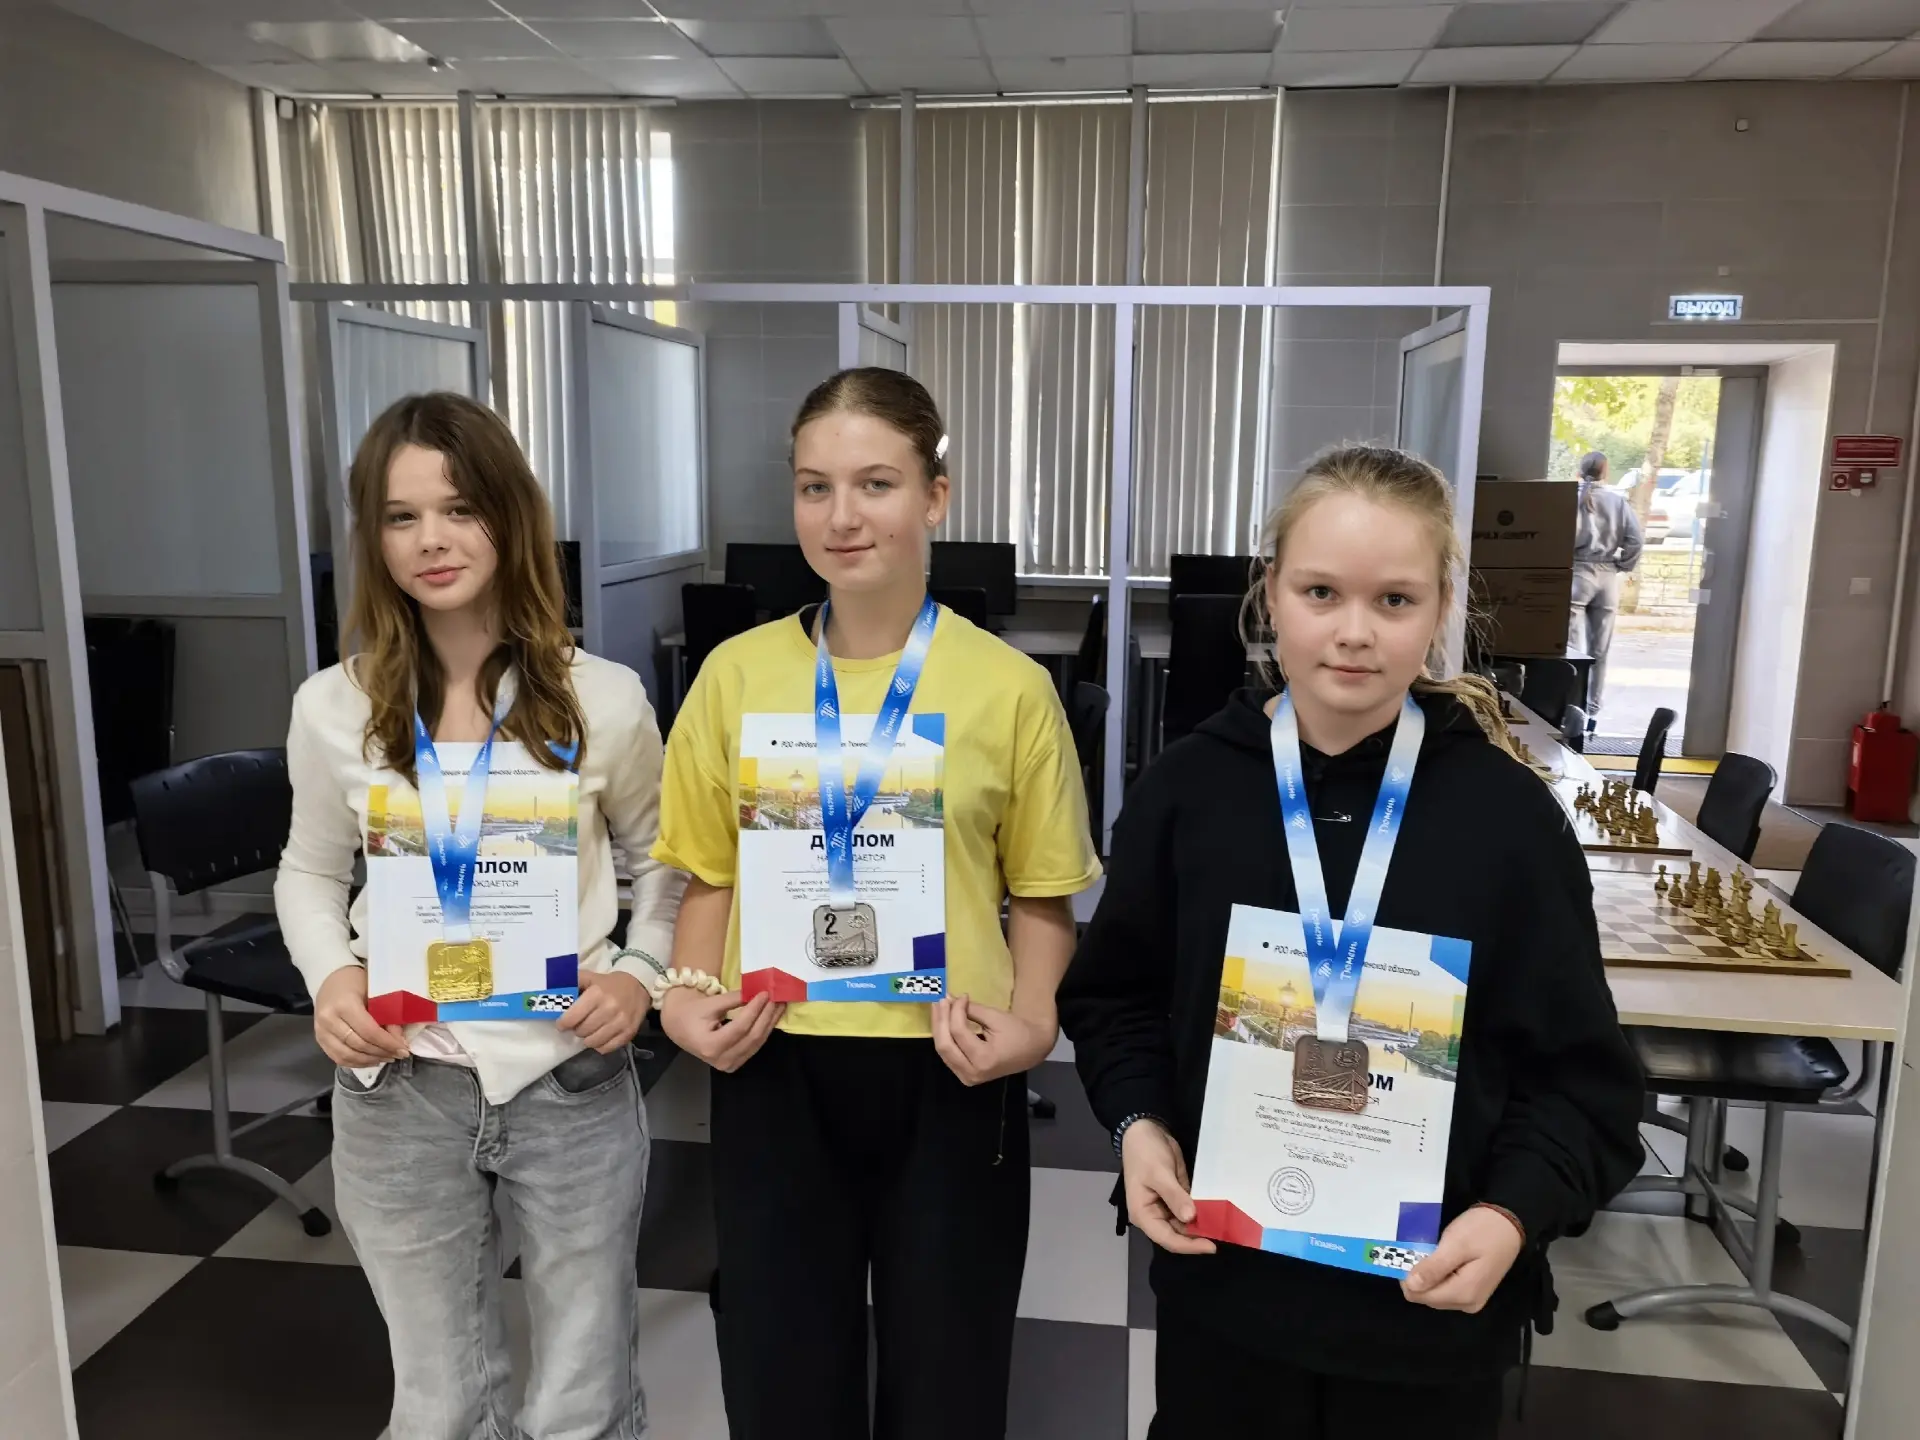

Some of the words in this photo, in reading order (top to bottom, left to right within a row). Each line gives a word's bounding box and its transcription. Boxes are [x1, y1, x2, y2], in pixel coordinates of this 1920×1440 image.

[1676, 301, 1735, 316] ВЫХОД
[881, 707, 900, 739] Тюмень
[1283, 763, 1297, 800] Тюмень
[825, 780, 835, 817] Тюмень
[1378, 797, 1397, 835] Тюмень
[810, 834, 895, 850] ДЛОМ
[474, 861, 528, 874] ПЛОМ
[816, 854, 887, 863] НАДАЕТСЯ
[455, 863, 467, 898] Тюмень
[823, 912, 838, 936] 2
[1309, 908, 1324, 947] Тюмень
[1339, 941, 1359, 981] Тюмень
[1309, 1236, 1347, 1253] Тюмень
